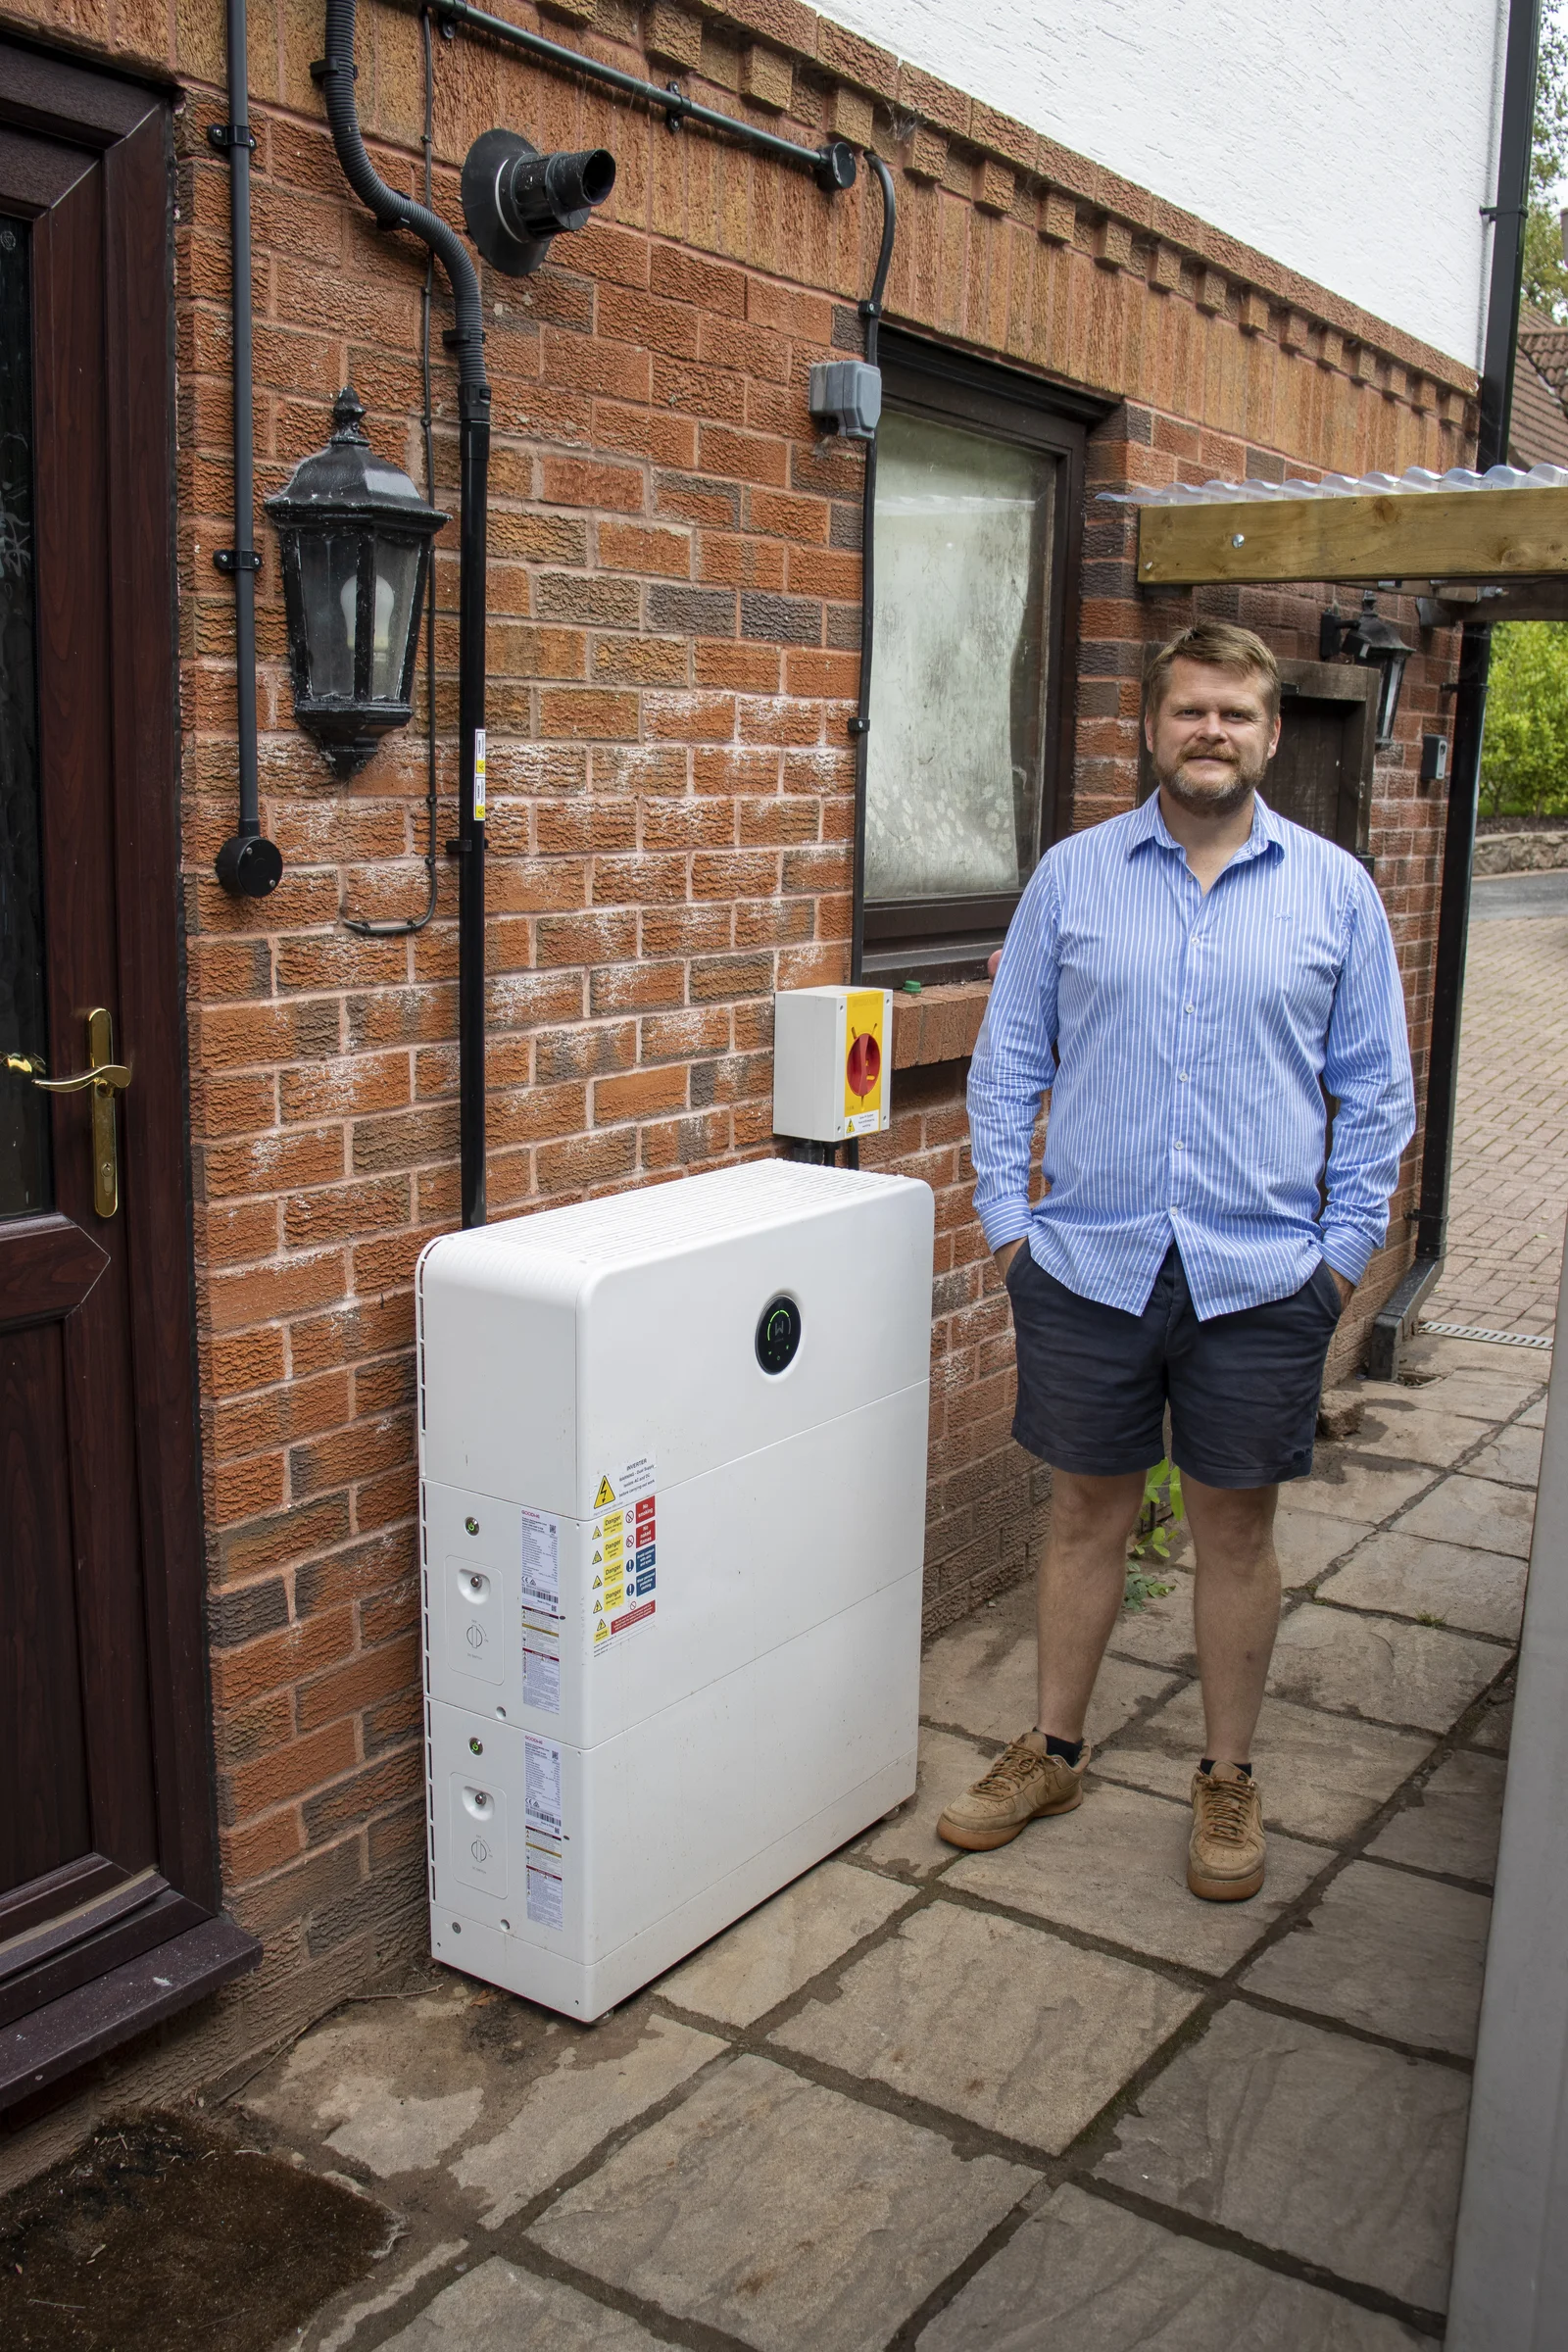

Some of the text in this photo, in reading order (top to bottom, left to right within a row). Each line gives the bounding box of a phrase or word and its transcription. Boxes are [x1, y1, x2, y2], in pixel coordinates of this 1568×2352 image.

[627, 1458, 647, 1471] INVERTER
[619, 1472, 634, 1482] WARNING
[638, 1508, 653, 1518] smoking
[606, 1515, 621, 1526] Danger
[606, 1540, 621, 1550] Danger
[606, 1564, 621, 1575] Danger
[606, 1589, 621, 1599] Danger
